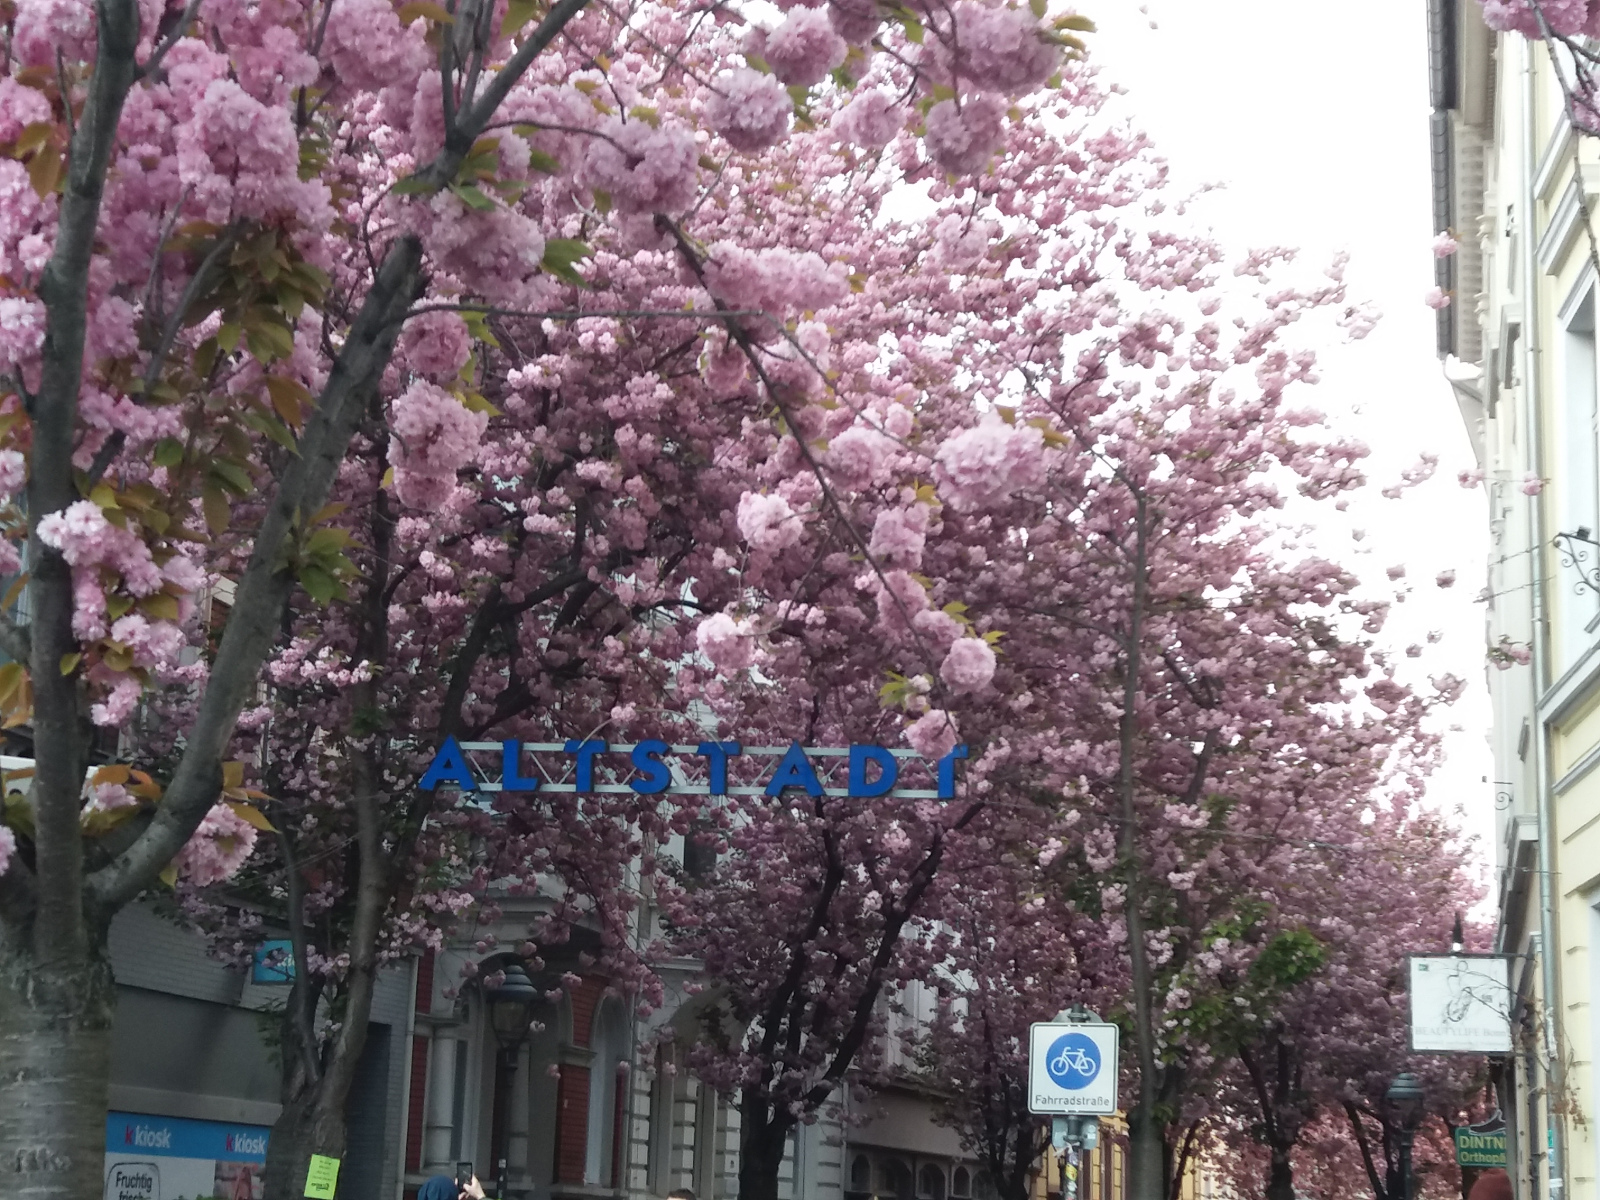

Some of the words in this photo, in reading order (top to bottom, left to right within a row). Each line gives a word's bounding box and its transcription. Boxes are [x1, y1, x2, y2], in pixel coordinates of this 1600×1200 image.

[418, 733, 969, 799] ALTSTADT
[1035, 1094, 1110, 1106] Fahrradstraße
[135, 1125, 171, 1148] kiosk
[234, 1133, 266, 1154] kiosk
[115, 1171, 153, 1193] Fruchtig
